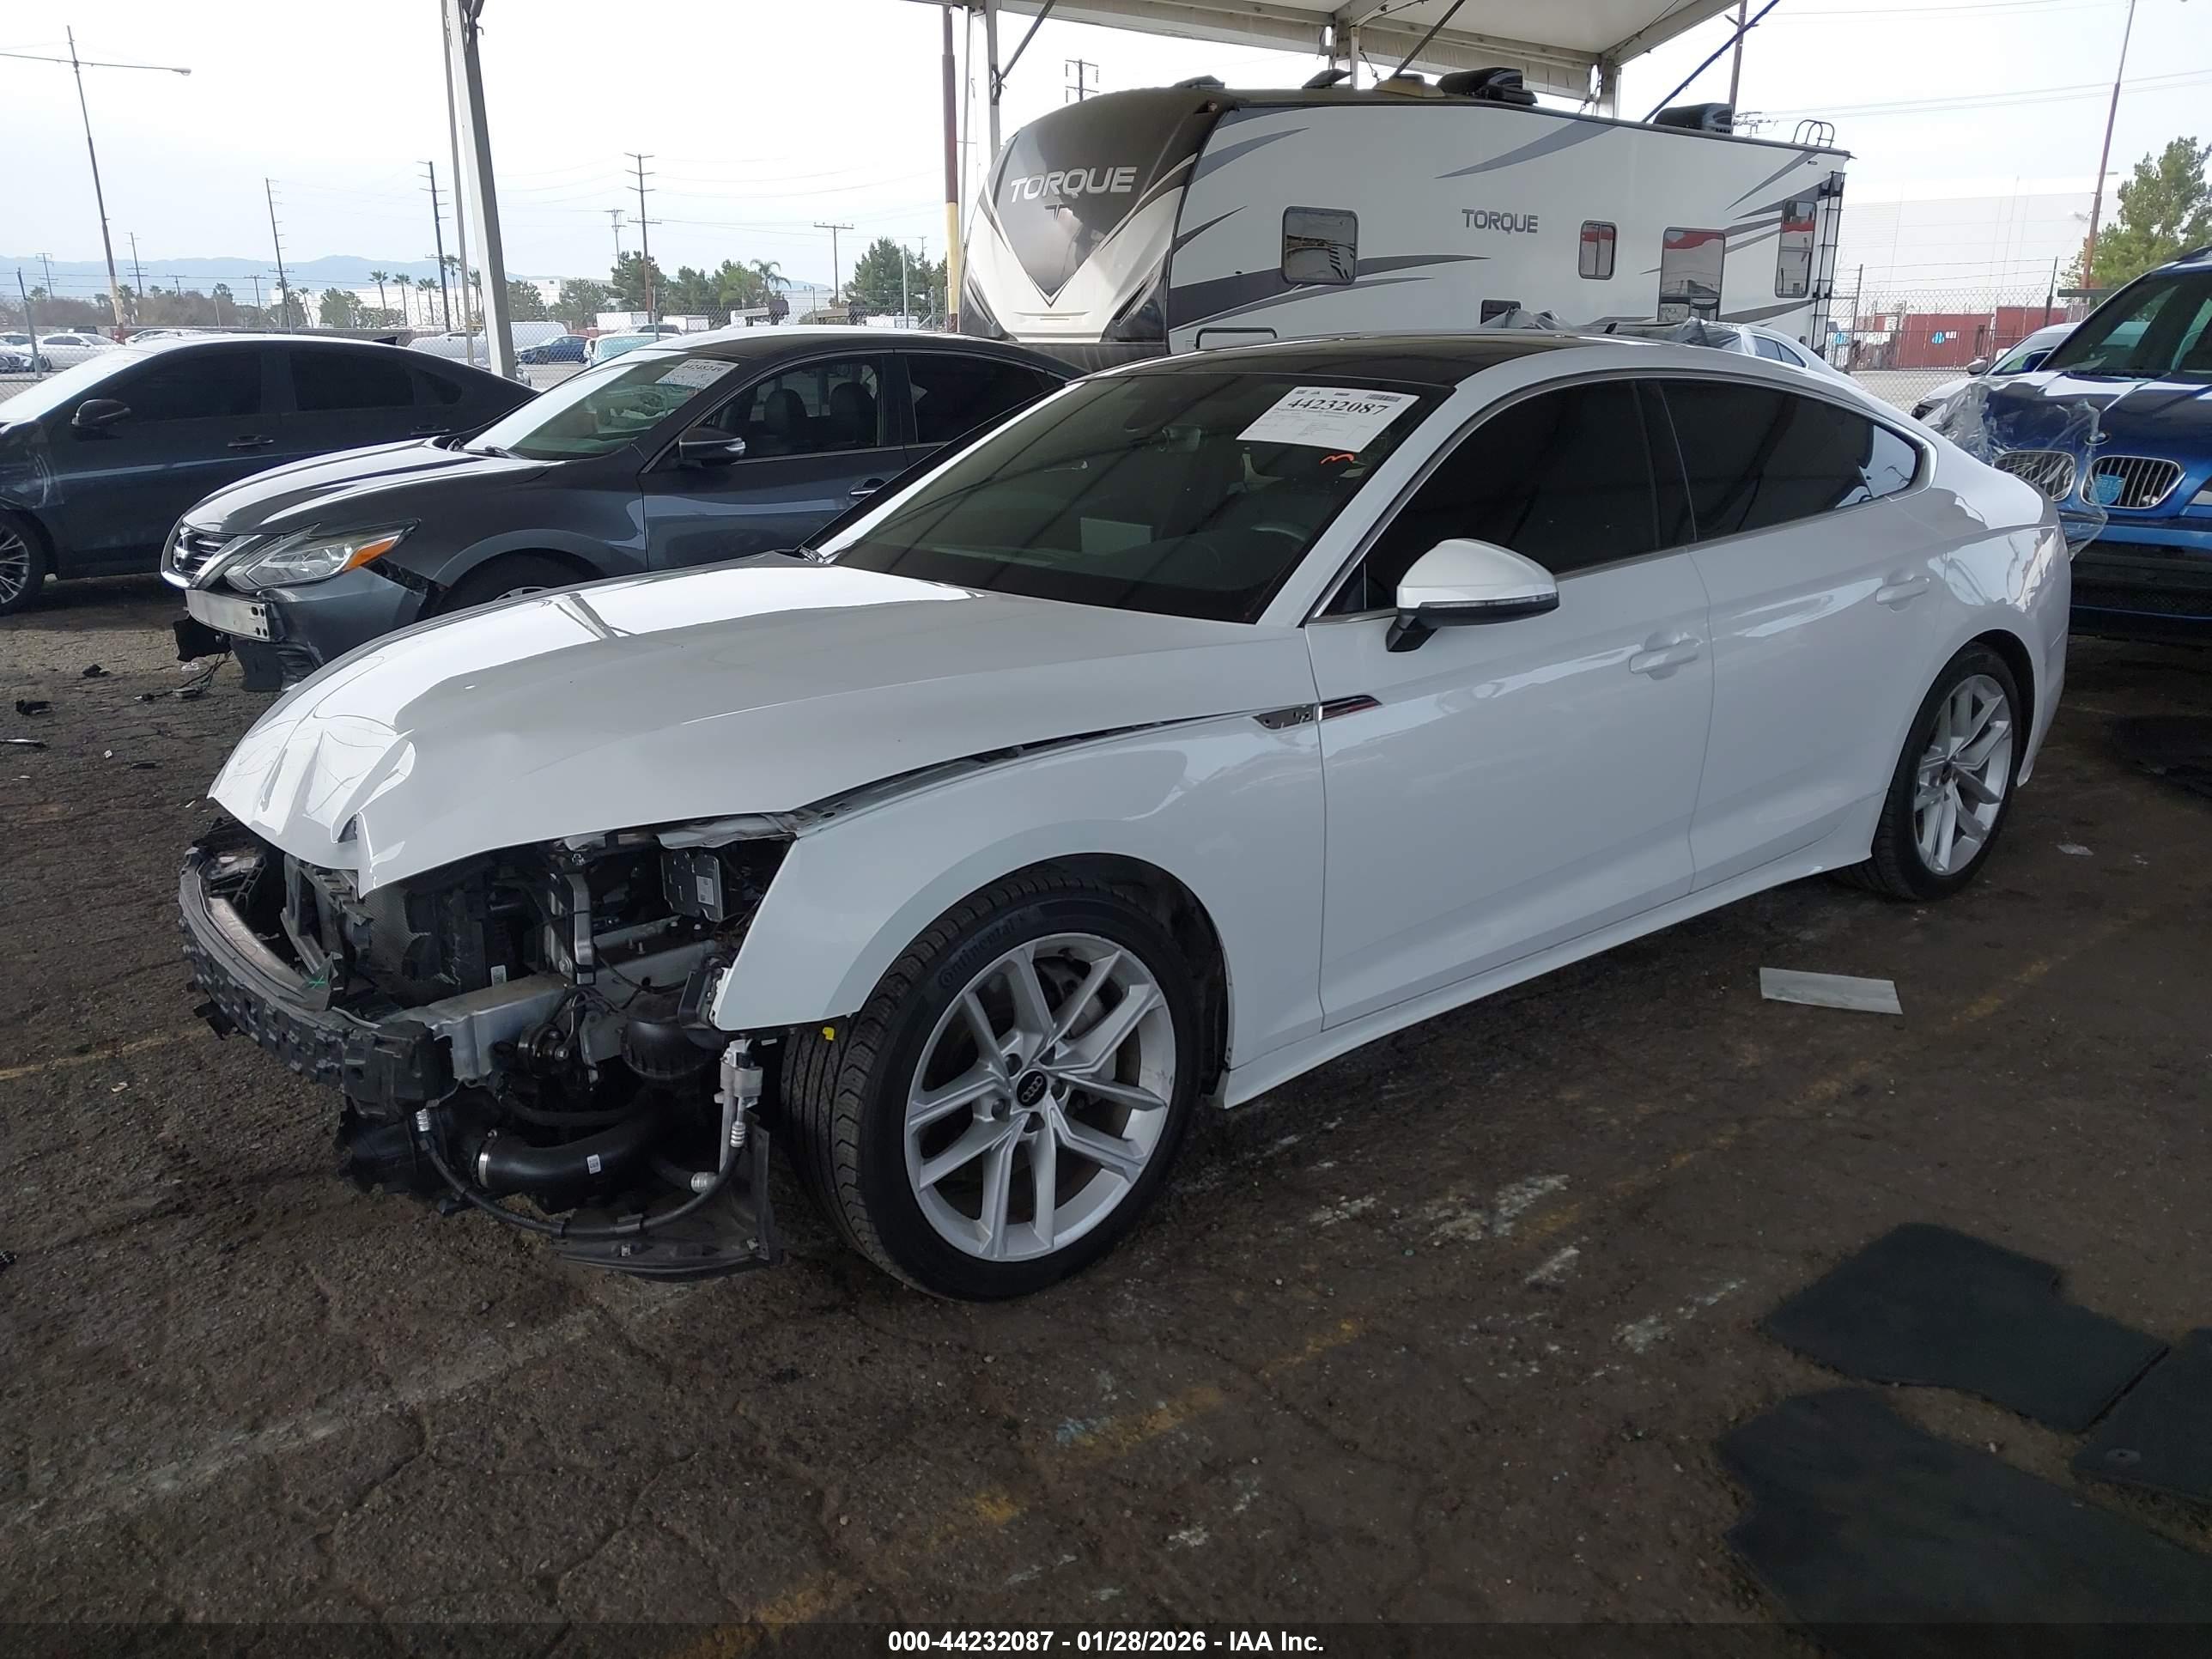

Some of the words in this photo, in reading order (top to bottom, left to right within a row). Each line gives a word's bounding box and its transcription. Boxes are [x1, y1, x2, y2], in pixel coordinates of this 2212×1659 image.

[1011, 166, 1138, 203] TORQUE
[1462, 209, 1539, 234] TORQUE
[1288, 398, 1390, 416] 44232087
